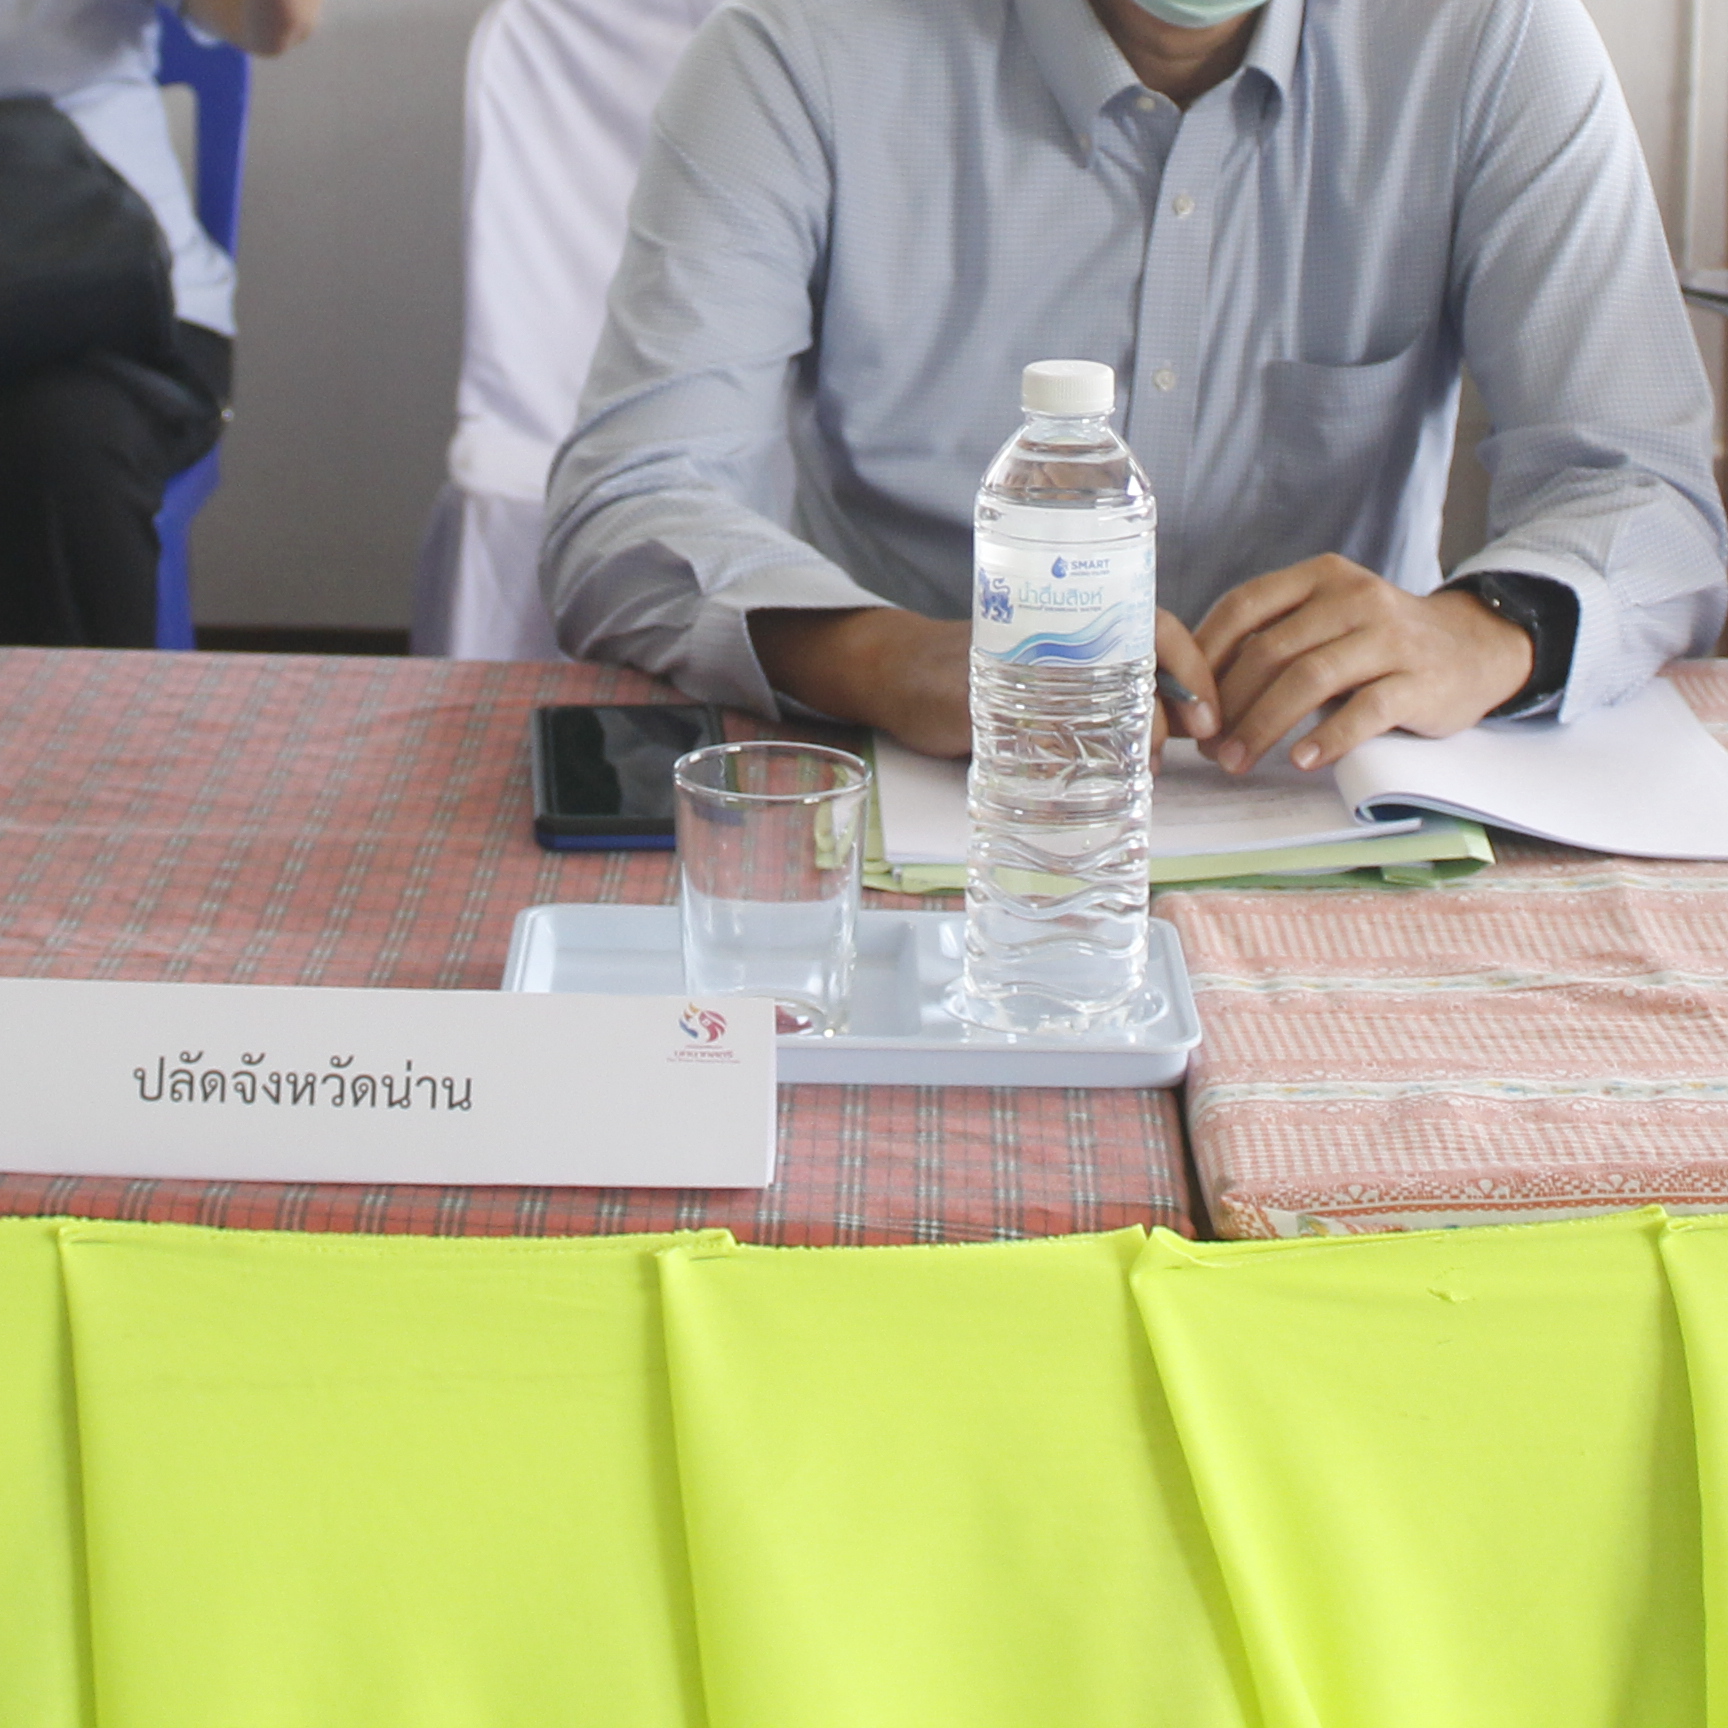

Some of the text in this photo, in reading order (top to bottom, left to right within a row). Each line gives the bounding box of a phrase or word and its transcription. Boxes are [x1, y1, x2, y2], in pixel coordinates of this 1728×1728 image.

[1070, 558, 1111, 570] SMART
[134, 1052, 473, 1112] ปลัดจังหวัดน่าน
